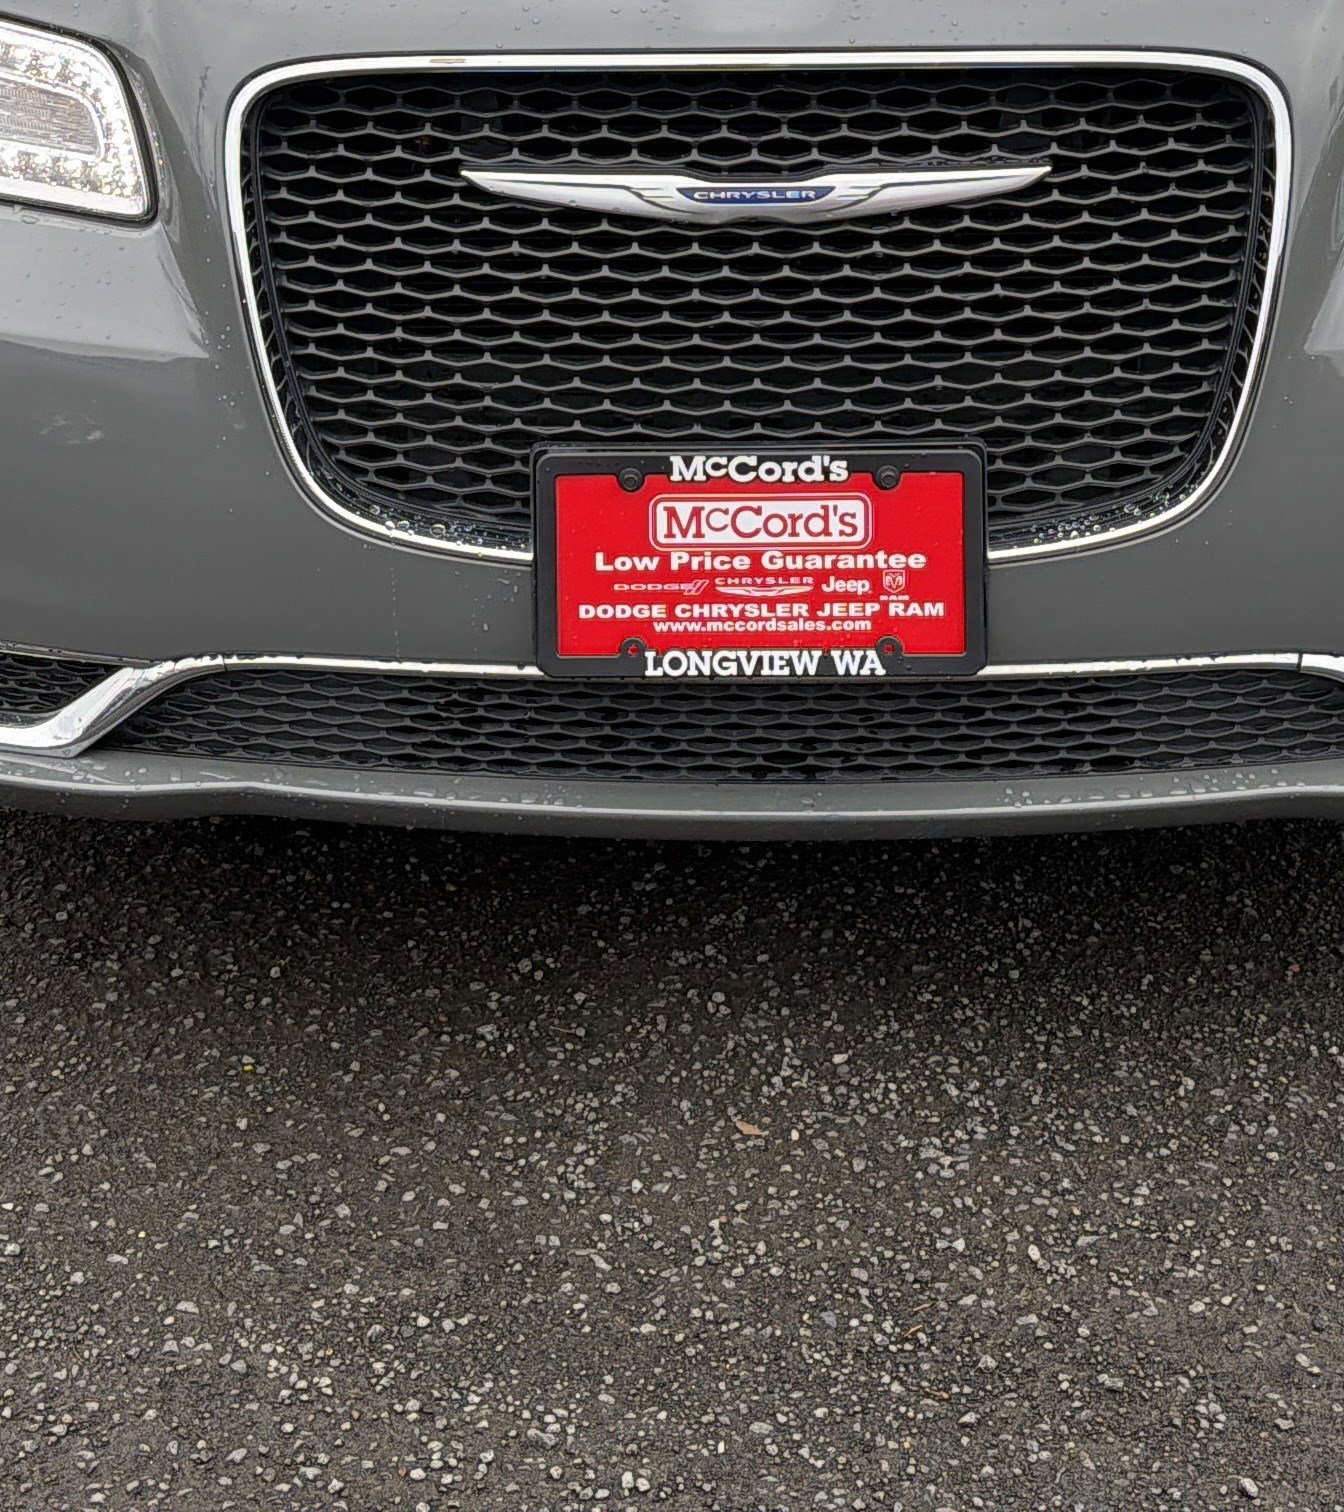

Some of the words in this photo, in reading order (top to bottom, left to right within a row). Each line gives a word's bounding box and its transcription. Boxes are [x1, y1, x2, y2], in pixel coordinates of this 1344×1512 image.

[693, 190, 816, 200] CHRYSLER
[669, 455, 849, 483] McCord's
[662, 504, 858, 539] McCord's
[595, 551, 660, 571] Low
[670, 551, 751, 571] Price
[761, 549, 927, 570] Guarantee
[613, 583, 696, 591] DODGE
[714, 576, 814, 586] CHRYSLER
[821, 575, 871, 596] Jeep
[578, 604, 667, 619] DODGE
[674, 603, 810, 618] CHRYSLER
[816, 602, 881, 617] JEEP
[888, 602, 945, 617] RAM
[652, 617, 872, 632] www.mccordsales.com
[644, 649, 823, 676] LONGVIEW
[830, 649, 887, 676] WA
